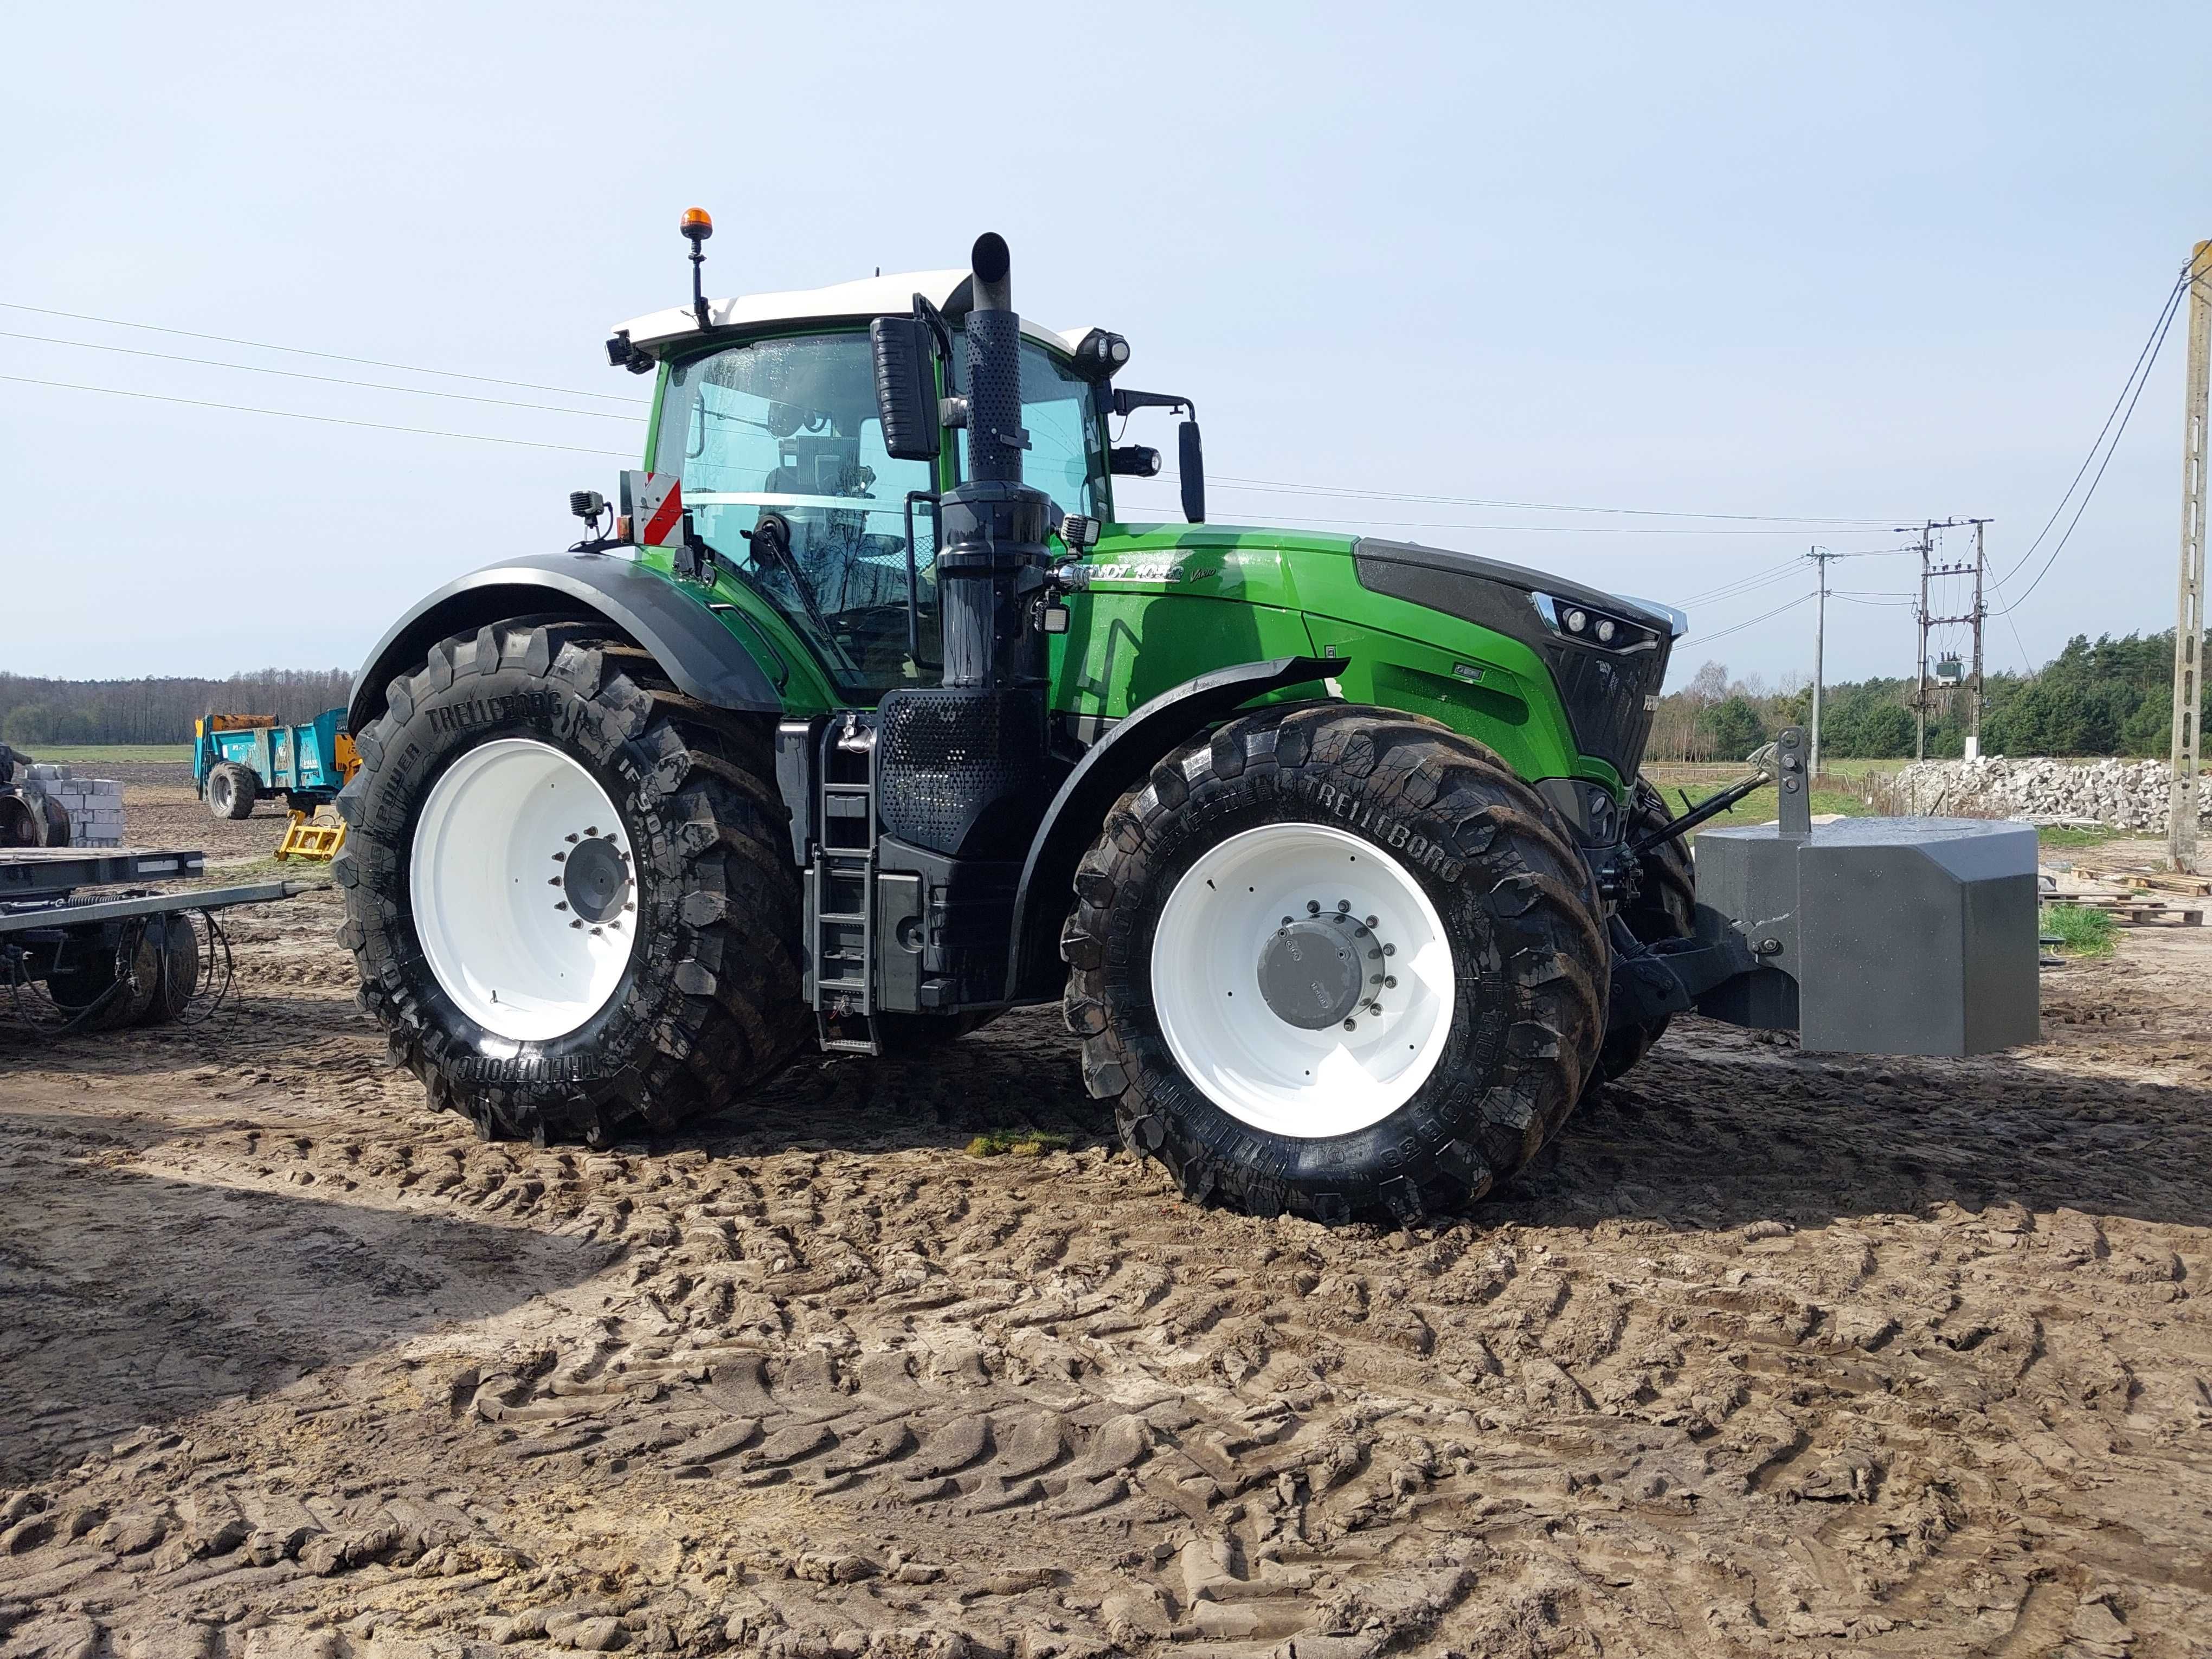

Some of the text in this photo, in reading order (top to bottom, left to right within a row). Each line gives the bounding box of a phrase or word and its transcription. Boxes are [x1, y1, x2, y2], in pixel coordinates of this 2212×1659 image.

[425, 690, 562, 731] TRELLEBORG
[376, 742, 421, 825] POWER
[619, 758, 640, 781] IF
[1303, 774, 1464, 883] TRELLEBORG
